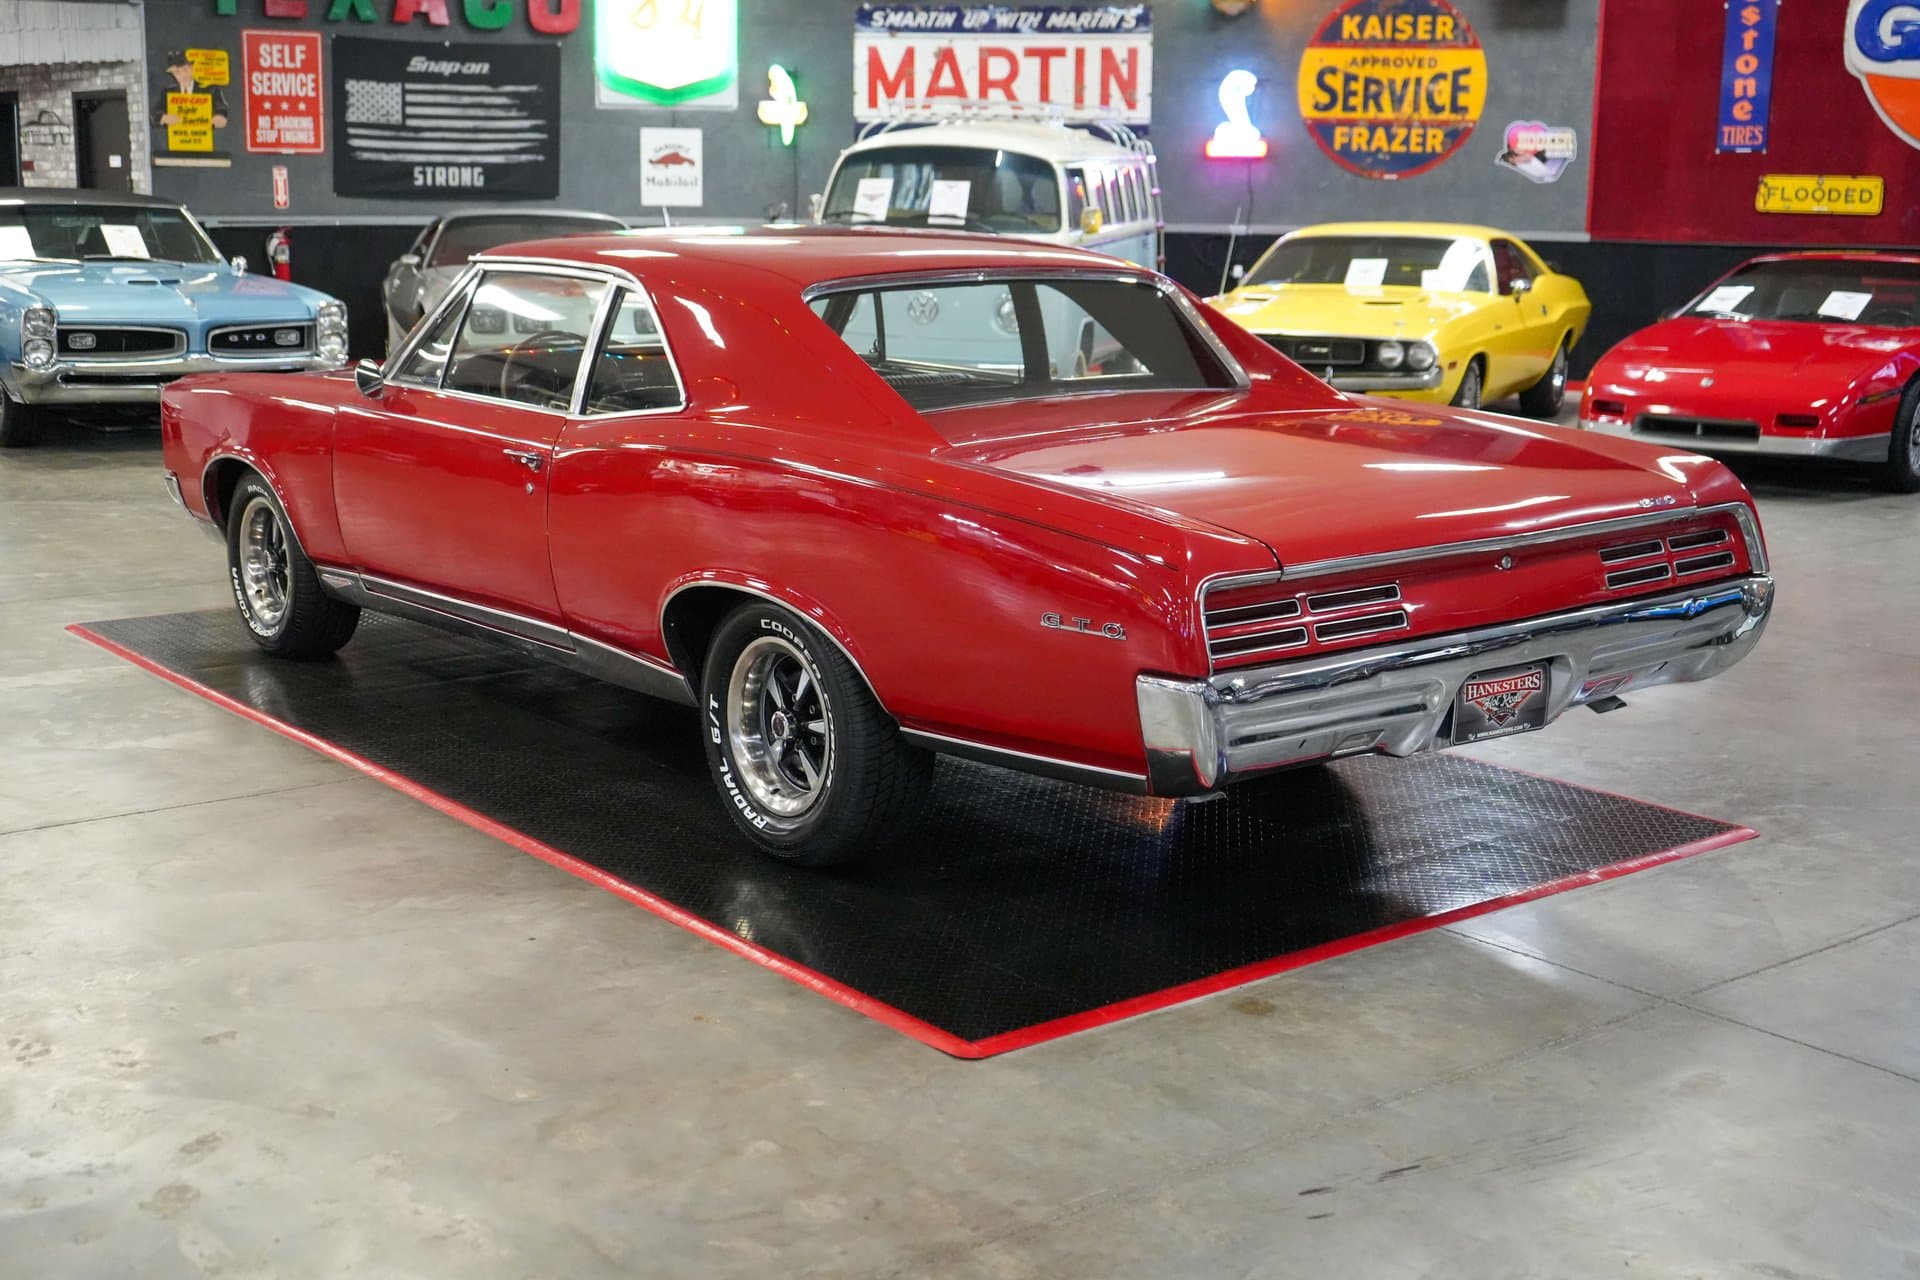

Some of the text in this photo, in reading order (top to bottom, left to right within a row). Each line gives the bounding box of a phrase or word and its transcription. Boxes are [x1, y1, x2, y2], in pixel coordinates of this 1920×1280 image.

[962, 10, 992, 28] UP
[996, 11, 1041, 29] WITH
[1341, 14, 1455, 41] KAISER
[259, 43, 306, 69] SELF
[406, 56, 490, 76] Snap-on
[1350, 55, 1438, 69] APPROVED
[252, 71, 317, 97] SERVICE
[867, 46, 1138, 110] MARTIN
[1313, 65, 1472, 115] SERVICE
[258, 115, 271, 129] NO
[256, 129, 315, 144] STOP ENGINES
[1333, 125, 1445, 153] FRAZER
[1722, 126, 1763, 146] TIRES
[413, 166, 485, 187] STRONG
[645, 176, 699, 187] Mobiloil
[1766, 186, 1874, 204] FLOODED
[228, 334, 267, 343] GTO
[1040, 611, 1126, 641] GTO
[760, 618, 821, 680] COOPER
[1466, 673, 1540, 701] HANKSTERS
[1484, 695, 1500, 710] Hot
[709, 693, 769, 831] RADIAL G/T
